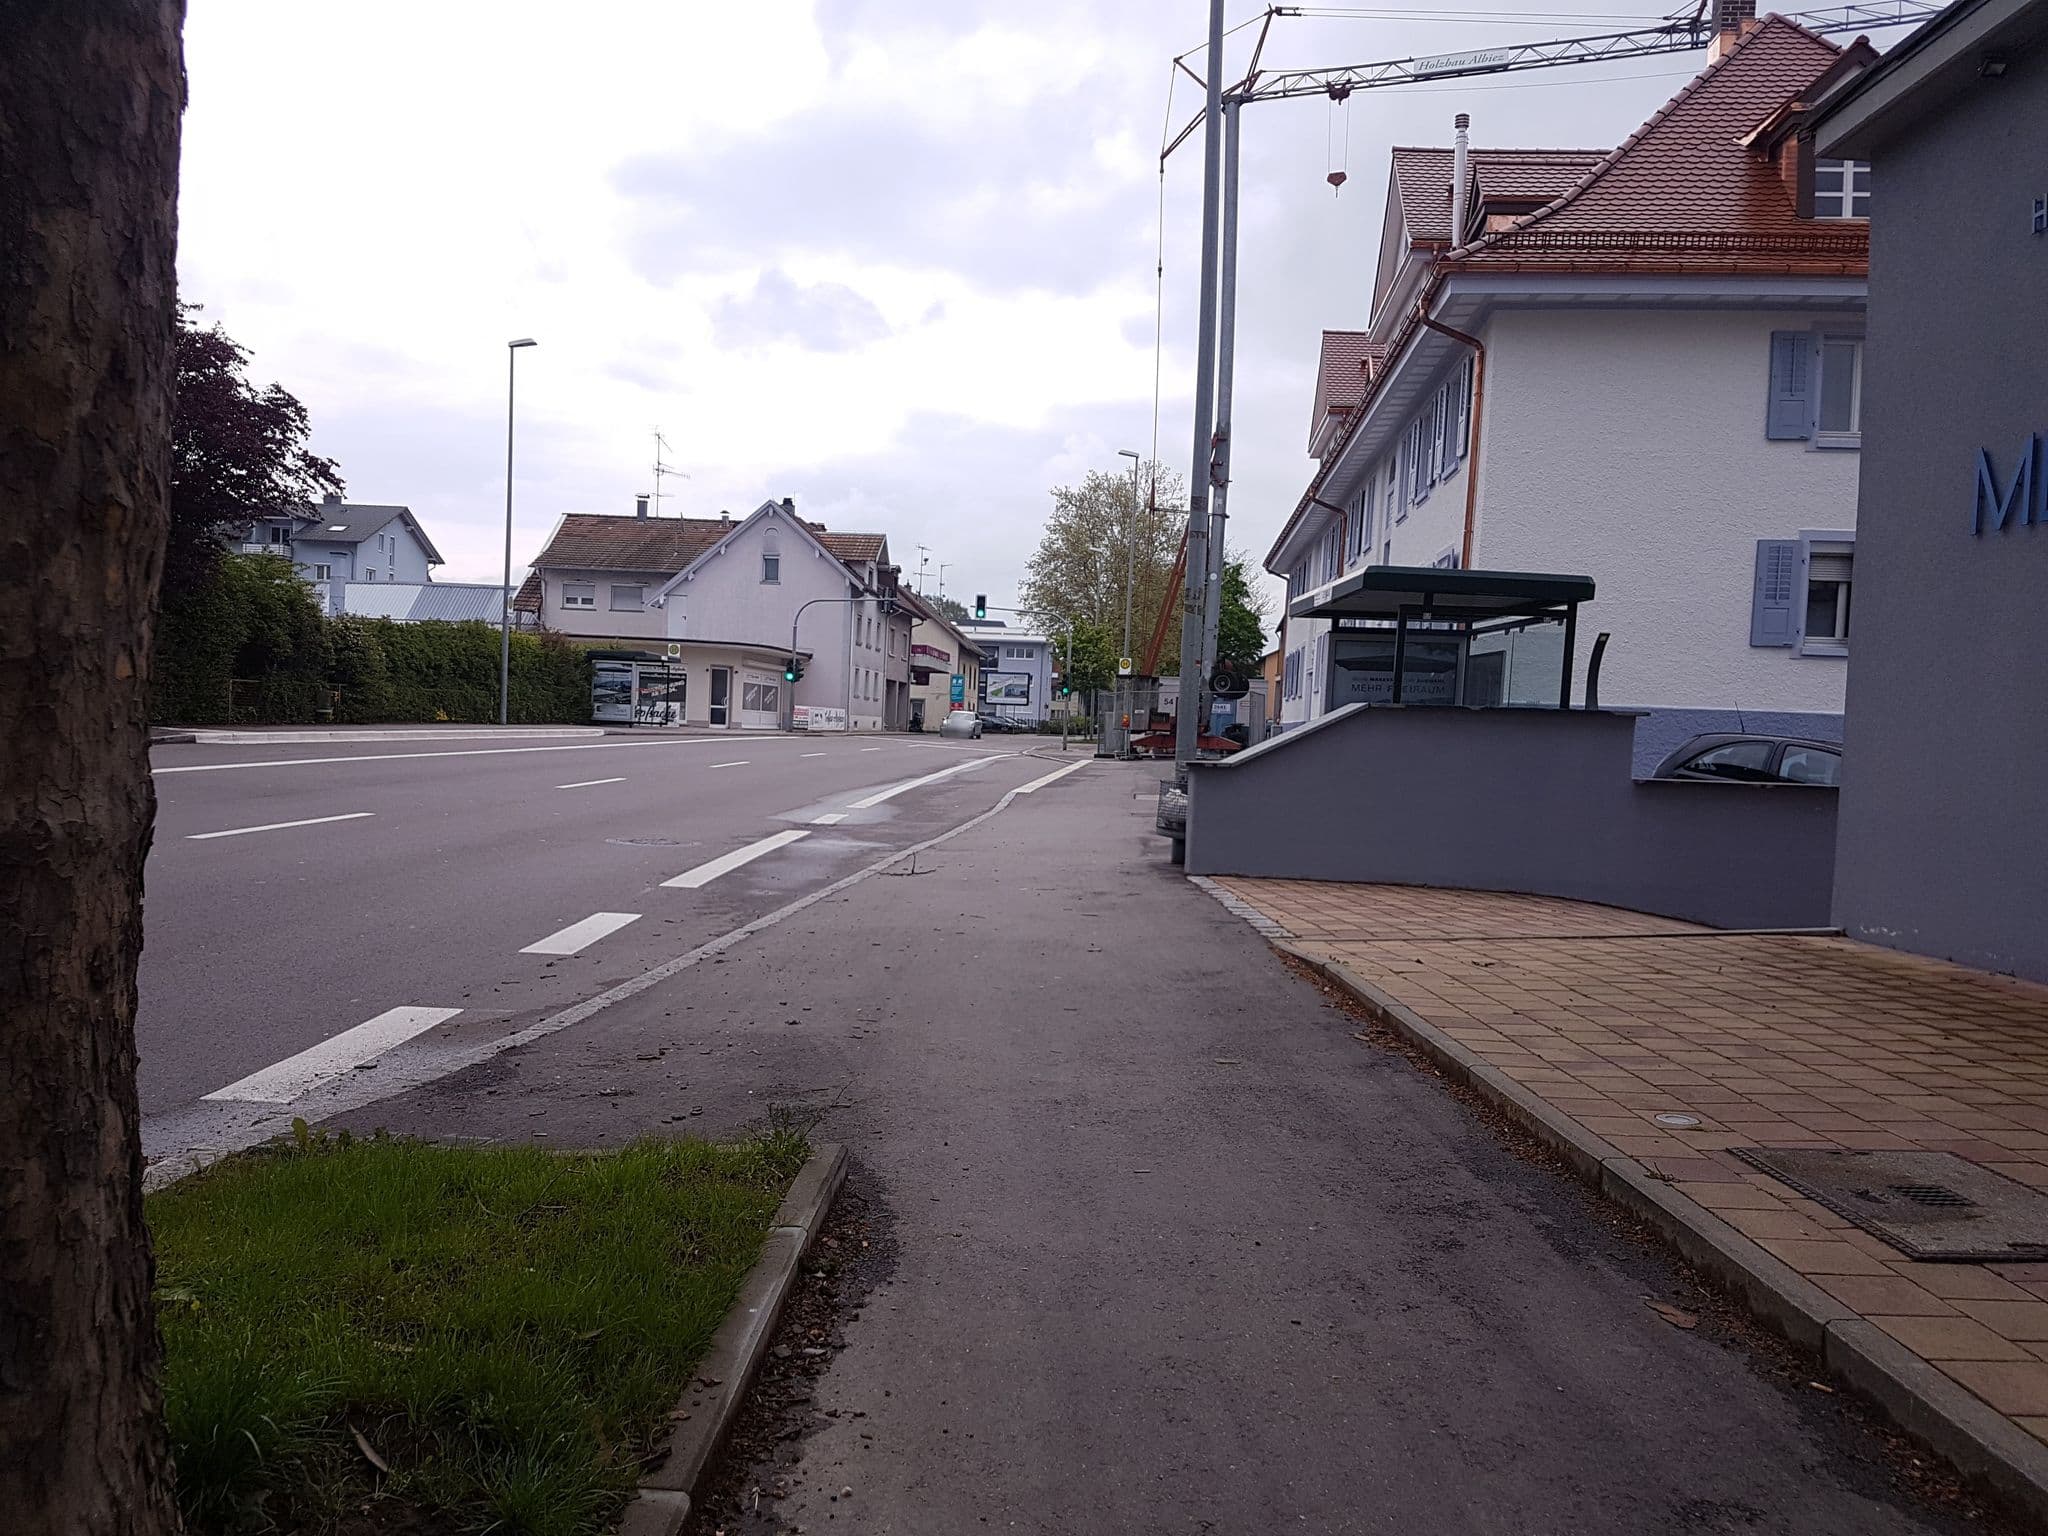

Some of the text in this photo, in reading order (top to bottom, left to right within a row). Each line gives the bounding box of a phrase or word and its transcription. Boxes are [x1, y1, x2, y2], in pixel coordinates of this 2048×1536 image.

[1418, 53, 1505, 71] Holzbau Albiez
[1969, 431, 2048, 536] M
[1351, 683, 1382, 693] MEHR
[1163, 697, 1174, 706] 54
